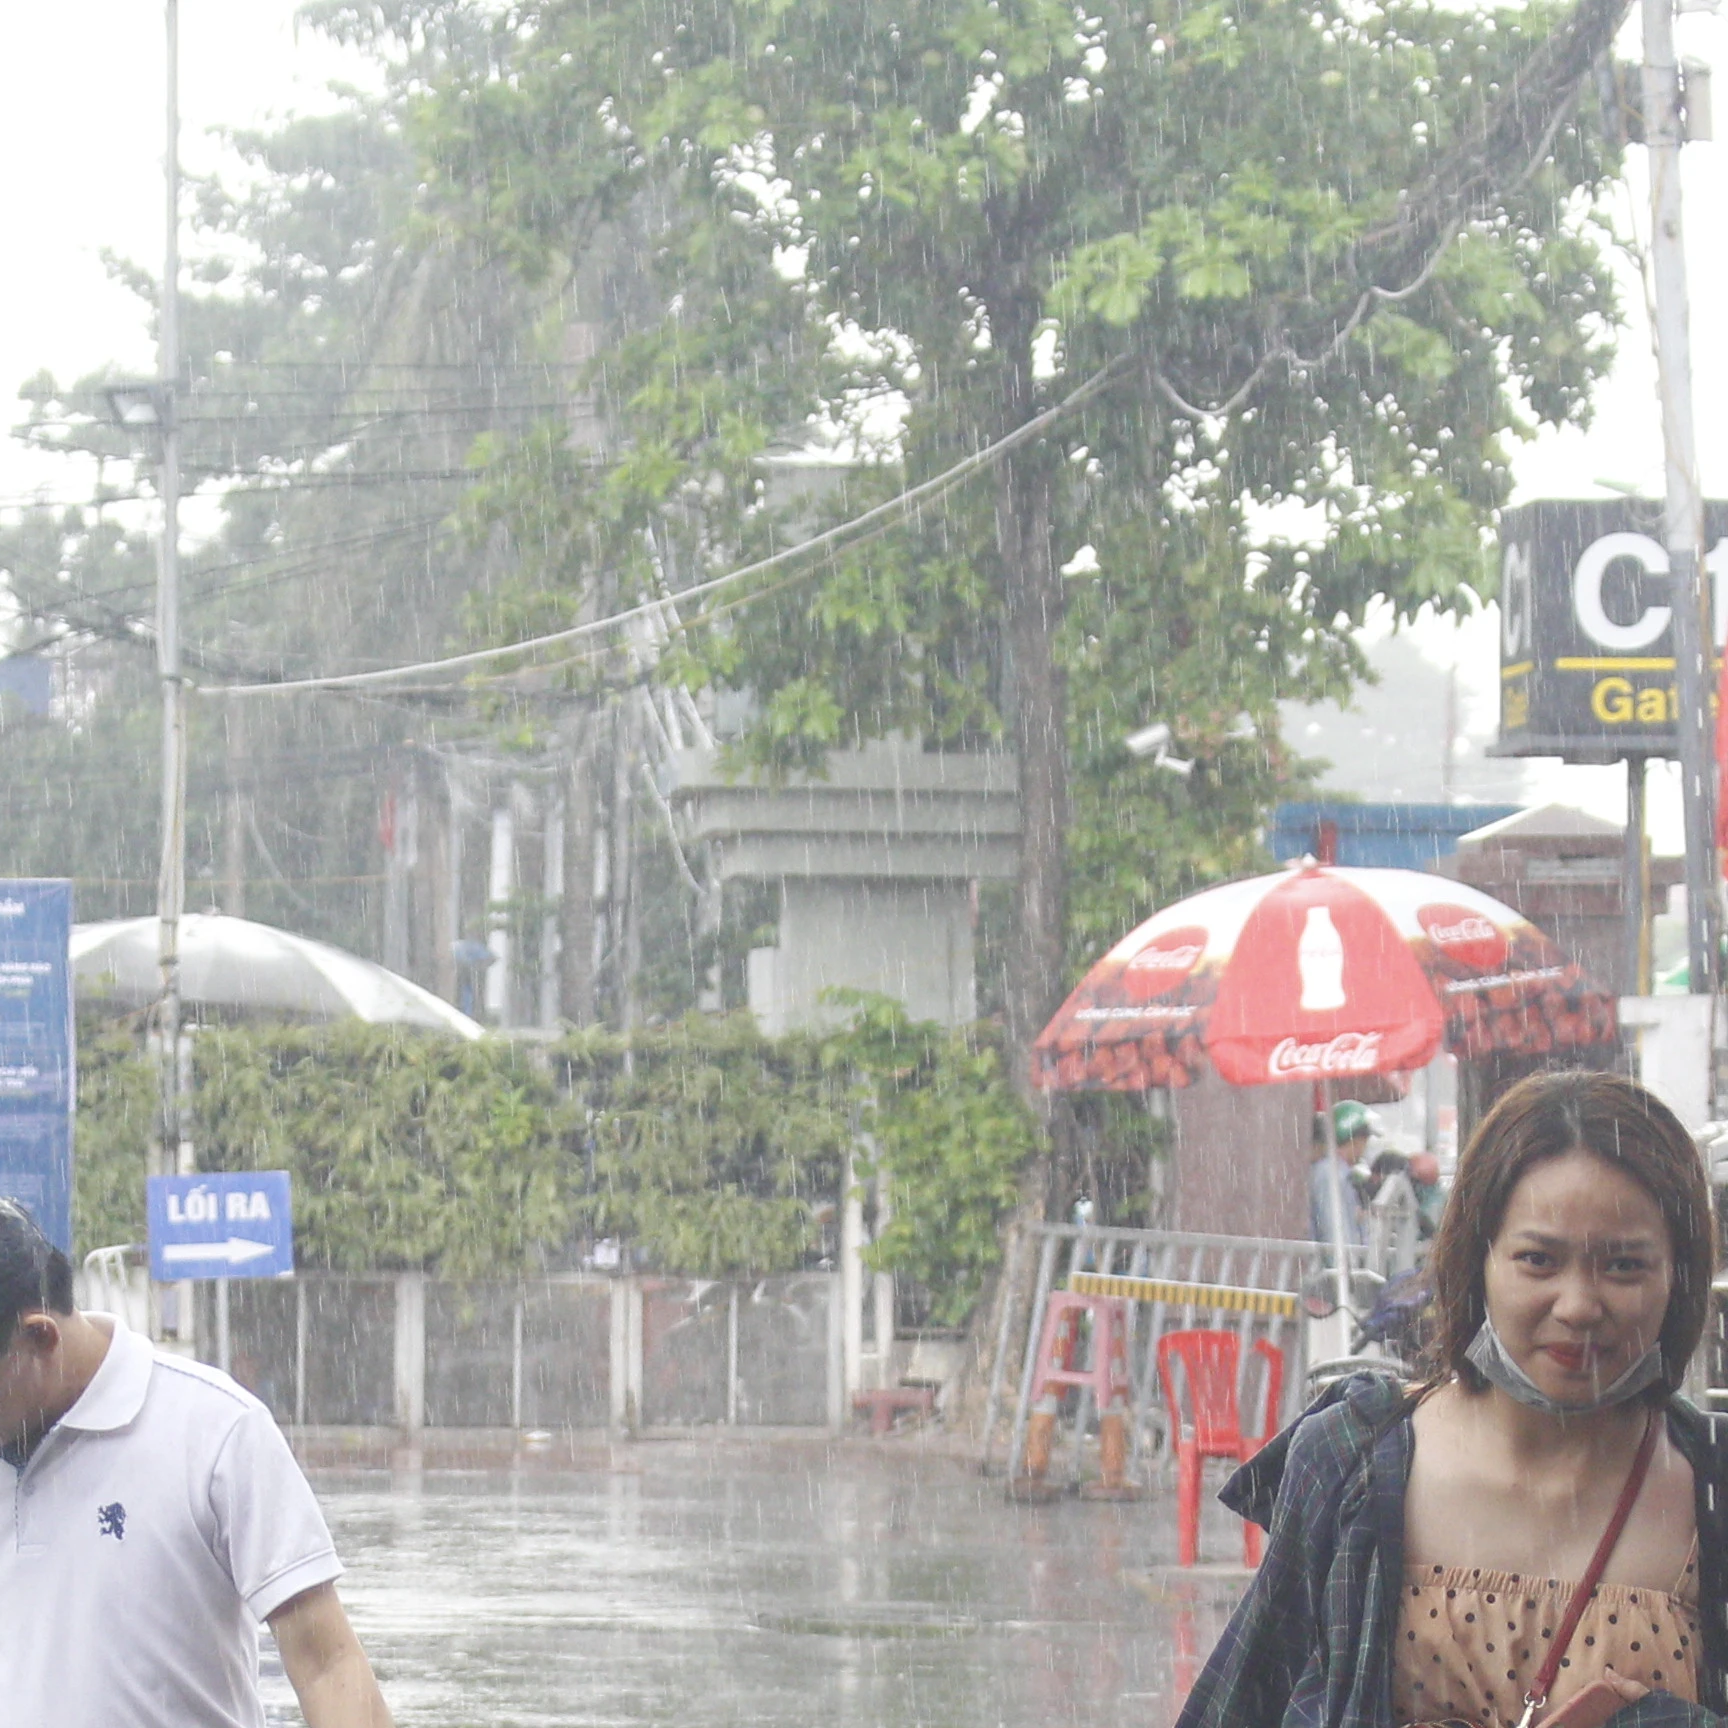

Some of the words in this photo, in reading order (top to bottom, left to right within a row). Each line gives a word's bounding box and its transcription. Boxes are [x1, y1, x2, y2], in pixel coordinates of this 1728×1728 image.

[1591, 677, 1720, 724] Ga
[168, 1184, 219, 1223] LỐI
[225, 1190, 272, 1221] RA
